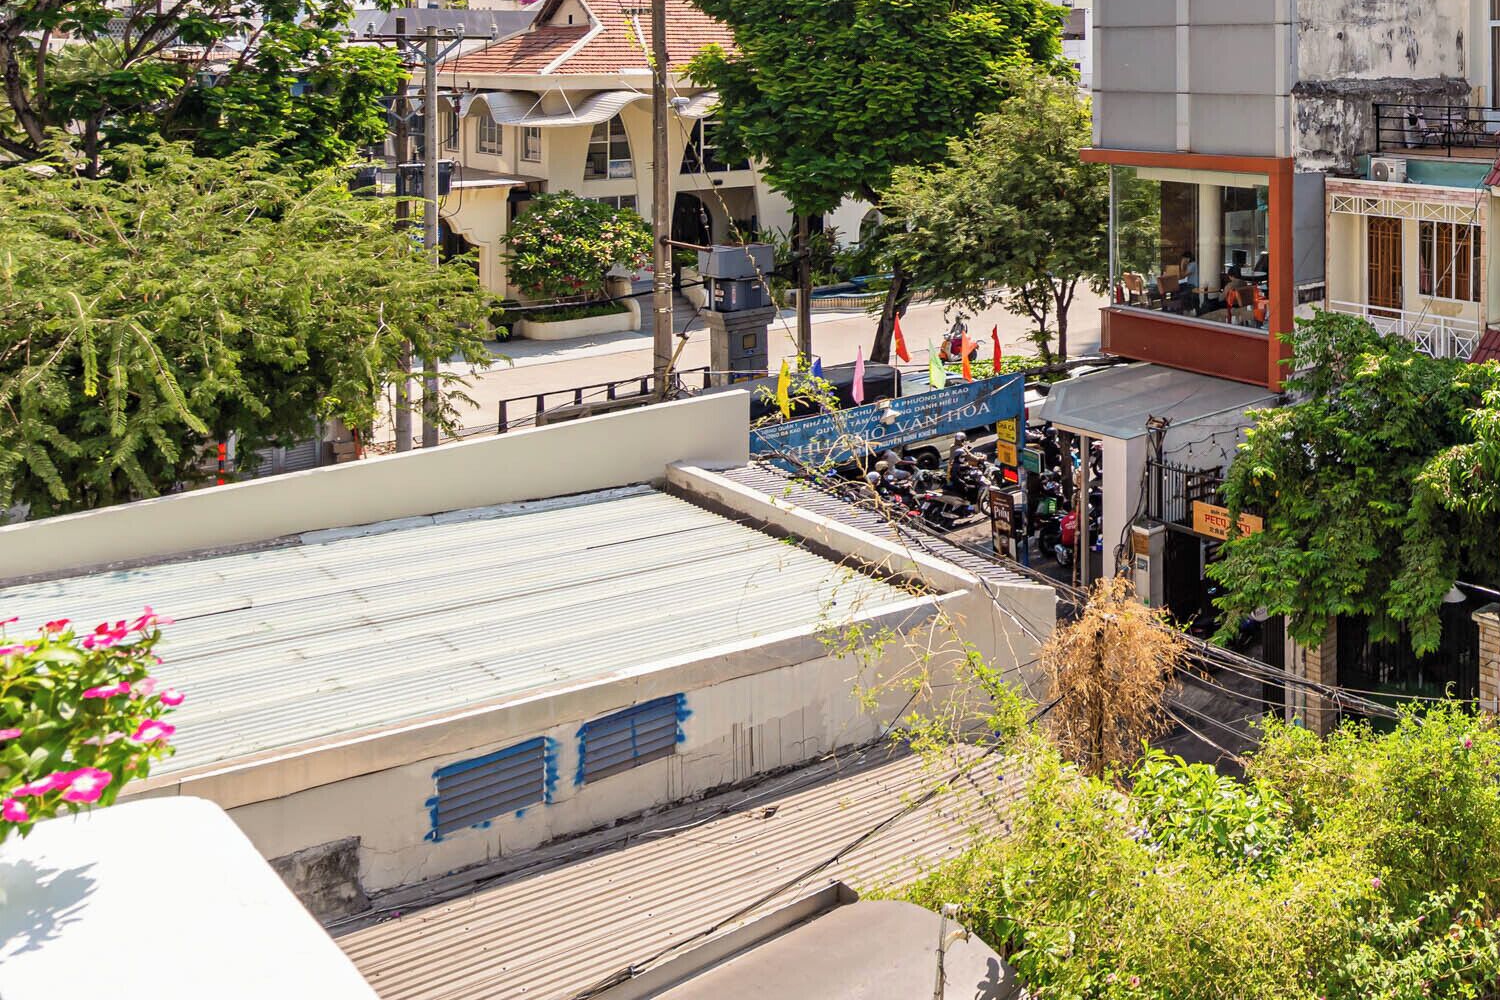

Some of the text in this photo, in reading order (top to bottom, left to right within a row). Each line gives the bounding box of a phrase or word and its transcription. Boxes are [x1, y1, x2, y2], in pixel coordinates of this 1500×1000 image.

[952, 386, 969, 395] KAO
[914, 402, 937, 412] DANH
[896, 413, 939, 433] VĂN
